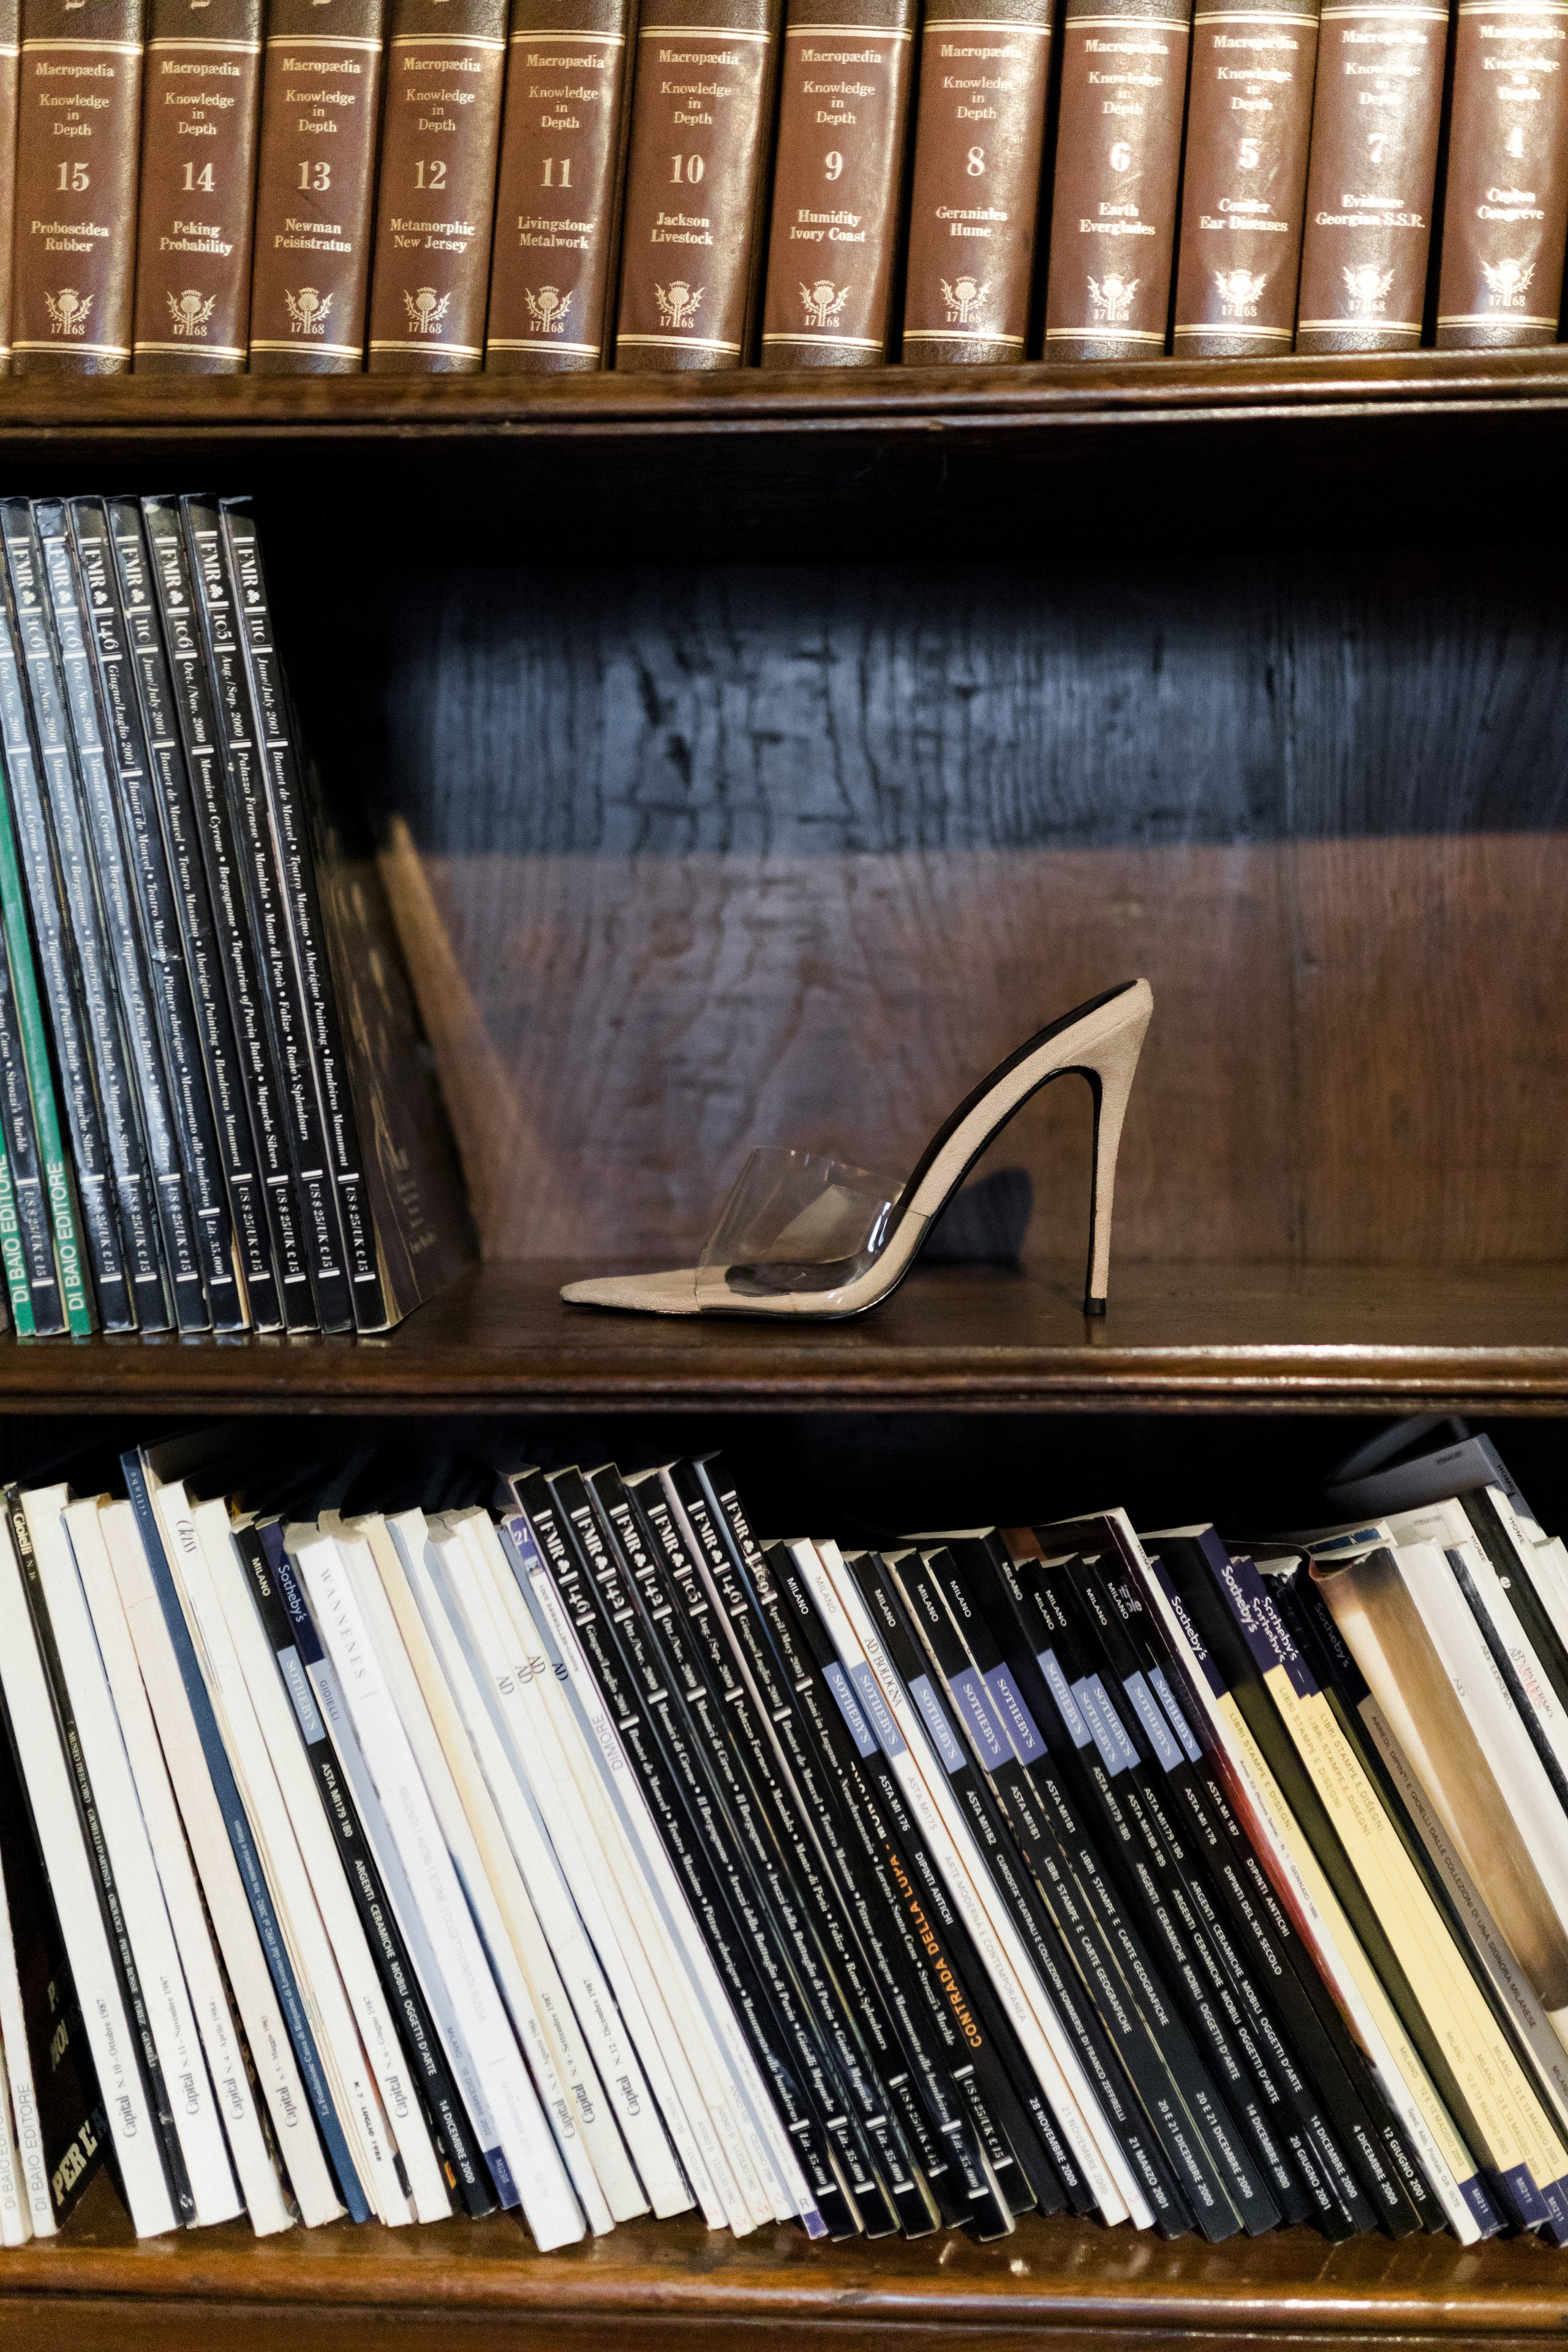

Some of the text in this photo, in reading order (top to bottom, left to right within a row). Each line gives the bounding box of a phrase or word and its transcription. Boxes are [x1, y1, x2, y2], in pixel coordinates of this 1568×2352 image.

[36, 62, 115, 77] Macropædia
[161, 61, 240, 77] Macropædia
[282, 59, 361, 75] Macropædia
[403, 58, 481, 74] Macropædia
[526, 54, 605, 69] Macropædia
[659, 50, 739, 66] Macropædia
[801, 50, 882, 64] Macropædia
[39, 94, 110, 108] Knowledge
[802, 81, 875, 97] Knowledge
[831, 97, 843, 108] in
[67, 108, 80, 120] in
[816, 111, 856, 126] Depth
[53, 124, 92, 137] Depth
[1505, 128, 1523, 158] 4
[967, 146, 985, 176] 8
[1110, 142, 1131, 172] 6
[1240, 138, 1259, 169] 5
[1368, 134, 1387, 162] 7
[57, 163, 89, 191] 15
[183, 163, 215, 192] 14
[298, 162, 331, 191] 13
[414, 160, 447, 190] 12
[540, 157, 571, 188] 11
[669, 154, 704, 184] 10
[826, 150, 843, 180] 9
[1099, 202, 1139, 217] Earth
[1219, 198, 1270, 214] Conifer
[1343, 195, 1404, 210] Evidence
[1488, 188, 1536, 204] Ceylon
[285, 219, 342, 235] Newman
[390, 219, 475, 237] Metamorphic
[517, 217, 595, 234] Livingstone
[656, 213, 710, 228] Jackson
[797, 209, 861, 227] Humidity
[936, 206, 1008, 222] Geraniales
[1080, 219, 1155, 236] Everglades
[1199, 215, 1287, 232] Ear Diseases
[1316, 212, 1425, 228] Georgian S.S.R.
[1478, 205, 1544, 222] Congreve
[31, 221, 109, 238] Proboscidea
[173, 221, 221, 239] Peking
[274, 235, 352, 252] Peisistratus
[520, 233, 589, 249] Metalwork
[650, 229, 714, 244] Livestock
[790, 225, 866, 243] Ivory Coast
[950, 221, 991, 237] Hume
[45, 238, 93, 252] Rubber
[160, 238, 233, 256] Probability
[394, 235, 468, 254] New Jersey
[84, 549, 105, 588] FMR
[200, 542, 221, 582] FMR
[237, 548, 258, 587] FMR
[97, 620, 119, 650] 146
[213, 614, 232, 639] 105
[250, 619, 266, 643] 110
[256, 657, 279, 734] June/July 2001
[108, 664, 135, 764] Giugno/Luglio 2001
[230, 711, 244, 737] 2000
[237, 752, 258, 838] Palazzo Farnese
[273, 751, 297, 840] Boutet de Monvel
[254, 852, 270, 899] Mamluks
[287, 854, 309, 937] Teatro Massimo
[264, 913, 285, 987] Monte di Pietà
[306, 951, 328, 1045] Aborigine Painting
[278, 1001, 292, 1032] Falize
[285, 1045, 308, 1140] Rome's Splendours
[323, 1058, 349, 1166] Bandeiras Monument
[51, 1162, 84, 1310] DI BAIO EDITORE
[205, 1220, 217, 1238] Lit.
[345, 1186, 356, 1202] US
[357, 1259, 368, 1271] 15
[13, 1513, 32, 1555] Gioielli
[26, 1559, 33, 1570] N.
[540, 1520, 565, 1559] FMR
[577, 1517, 603, 1556] FMR
[1509, 1516, 1525, 1545] HOME
[251, 1557, 271, 1596] MILANO
[277, 1564, 304, 1623] Sotheby's
[568, 1584, 590, 1613] 146
[605, 1579, 625, 1609] 142
[786, 1577, 809, 1615] MILANO
[1221, 1561, 1259, 1633] Sotheby's
[320, 1569, 364, 1678] WANNENES
[1170, 1595, 1207, 1660] Sotheby's
[527, 1656, 546, 1674] AD
[552, 1662, 568, 1681] AD
[319, 1679, 339, 1721] GIOIELLI
[997, 1678, 1035, 1748] SOTHEBY'S
[591, 1714, 624, 1771] DIMORE
[321, 1763, 353, 1837] ASTA MI179 180
[914, 1851, 954, 1924] DIPINTI ANTICHI
[910, 1900, 940, 1955] DELLA
[1223, 1865, 1282, 1975] DIPINTI DEL XIX SECOLO
[354, 1860, 437, 2076] ARGENTI CERAMICHE MOBILI OGGETTI D'ARTE
[935, 1957, 982, 2047] CONTRADA
[115, 2094, 137, 2138] Capital
[17, 2081, 47, 2211] DI BAIO EDITORE
[439, 2099, 475, 2184] 14 DICEMBRE 2000
[1029, 2097, 1077, 2187] 28 NOVEMBRE 2000
[52, 2143, 87, 2206] PER
[1128, 2136, 1169, 2209] 21 MARZO 2001
[1383, 2126, 1426, 2201] 12 GIUGNO 2001
